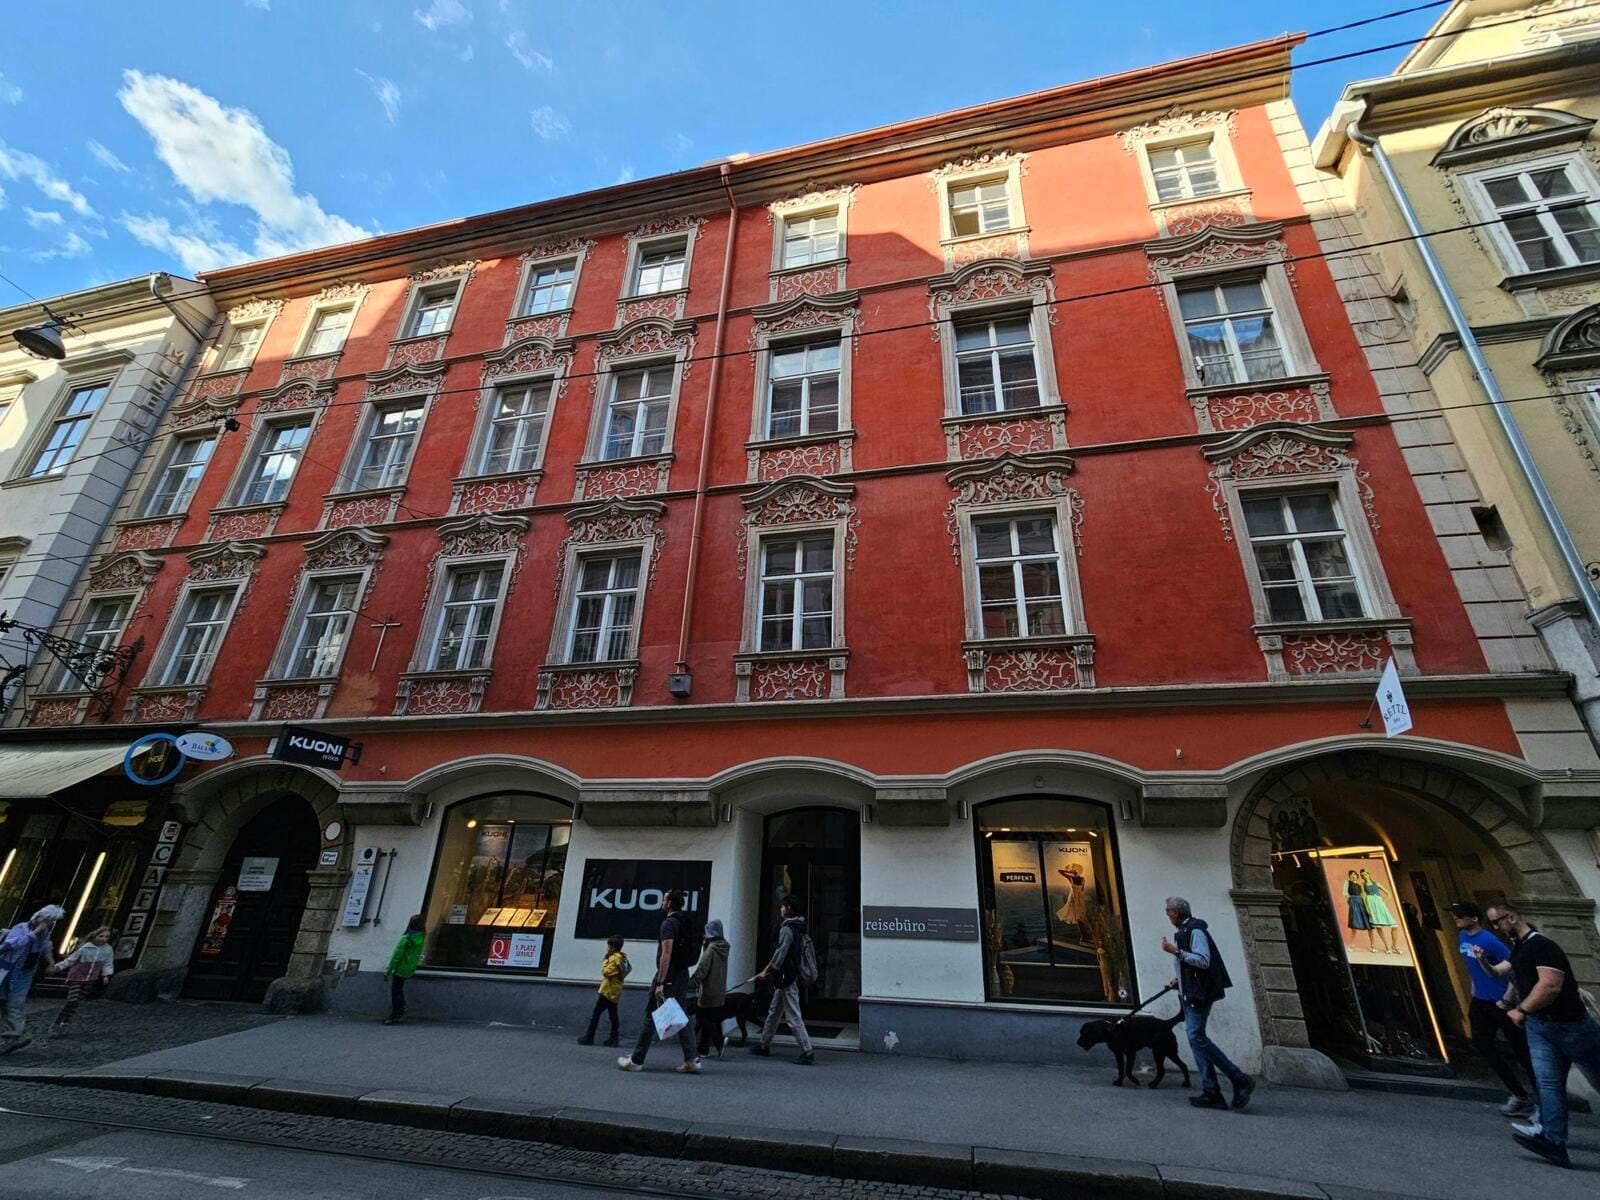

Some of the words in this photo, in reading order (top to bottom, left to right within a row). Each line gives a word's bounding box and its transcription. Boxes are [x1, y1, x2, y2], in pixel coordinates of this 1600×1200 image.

[289, 735, 343, 755] KUONI
[865, 917, 926, 932] reisebüro
[491, 939, 505, 958] Q
